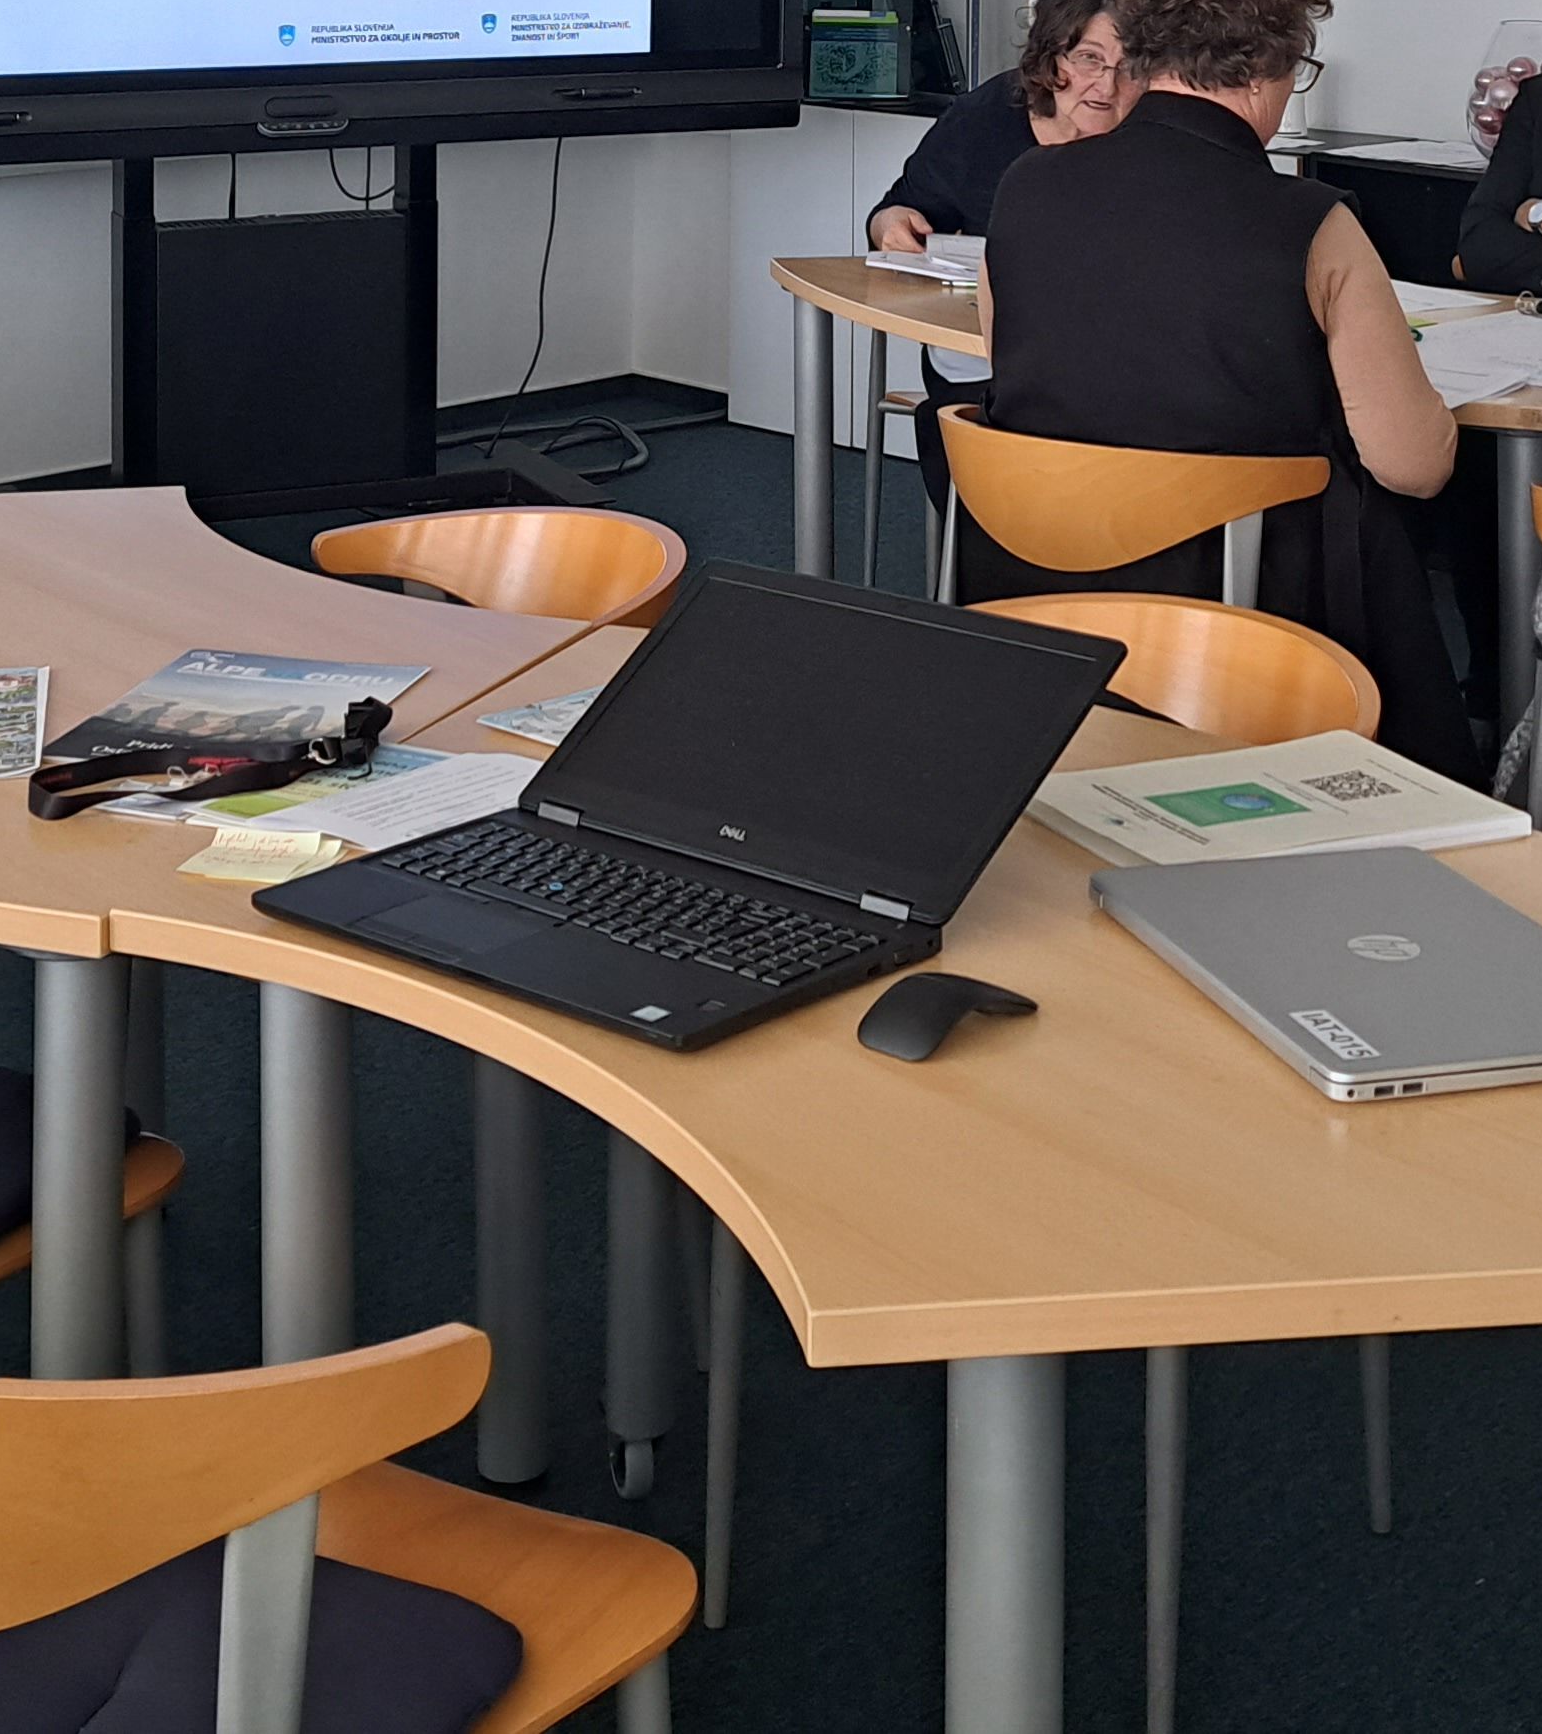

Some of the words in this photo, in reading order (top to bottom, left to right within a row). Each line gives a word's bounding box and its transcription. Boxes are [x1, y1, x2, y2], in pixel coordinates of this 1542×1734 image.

[511, 13, 552, 22] REPUBLIKA
[553, 12, 590, 21] SLOVENIJA
[311, 24, 353, 34] REPUBLIKA
[354, 23, 395, 33] SLOVENIJA
[511, 23, 560, 32] MINISTRSTVO
[561, 22, 572, 31] ZA
[311, 33, 367, 44] MINISTRSTVO
[368, 33, 379, 43] ZA
[380, 33, 410, 43] OKOLJE
[412, 31, 421, 41] IN
[422, 31, 460, 41] PROSTOR
[177, 662, 266, 677] ALPE
[303, 672, 395, 685] ODRU
[1300, 1012, 1373, 1058] IAT-015
